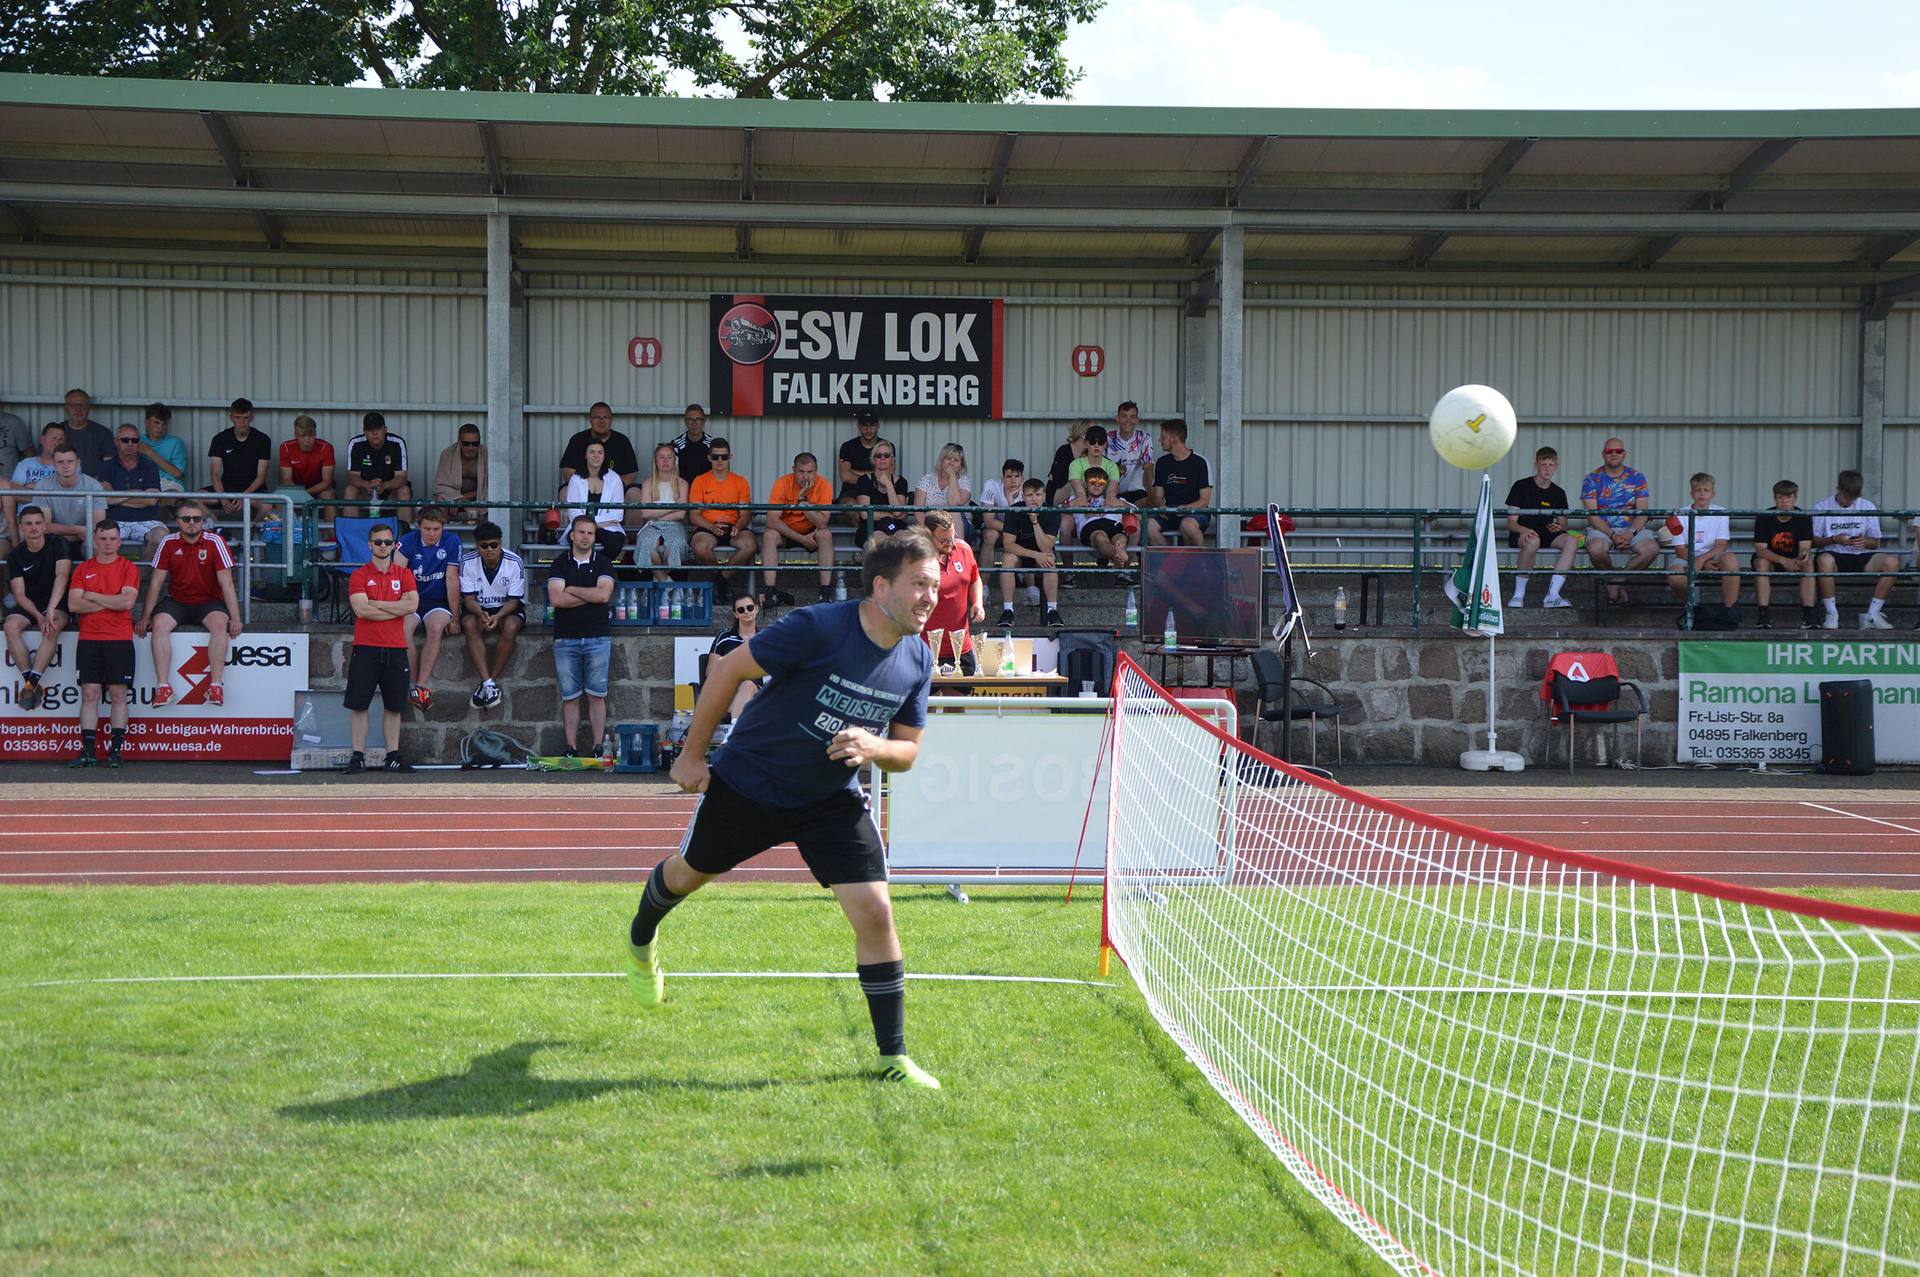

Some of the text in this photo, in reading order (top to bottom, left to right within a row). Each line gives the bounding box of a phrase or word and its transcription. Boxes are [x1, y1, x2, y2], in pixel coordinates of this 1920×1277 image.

[773, 310, 980, 362] ESV LOK
[772, 372, 980, 406] FALKENBERG
[224, 645, 292, 667] uesa
[1766, 643, 1920, 666] IHR PARTN
[1688, 680, 1796, 704] Ramona
[1688, 711, 1784, 724] Fr.-List-Str. 8a
[0, 723, 294, 737] bepark-Nord 038 Uebigau-Wahrenbrück
[1688, 729, 1808, 744] 04895 Falkenberg
[103, 740, 135, 752] Wb:
[138, 740, 222, 752] www.uesa.de
[1689, 747, 1811, 759] Tel.: 035365 38345
